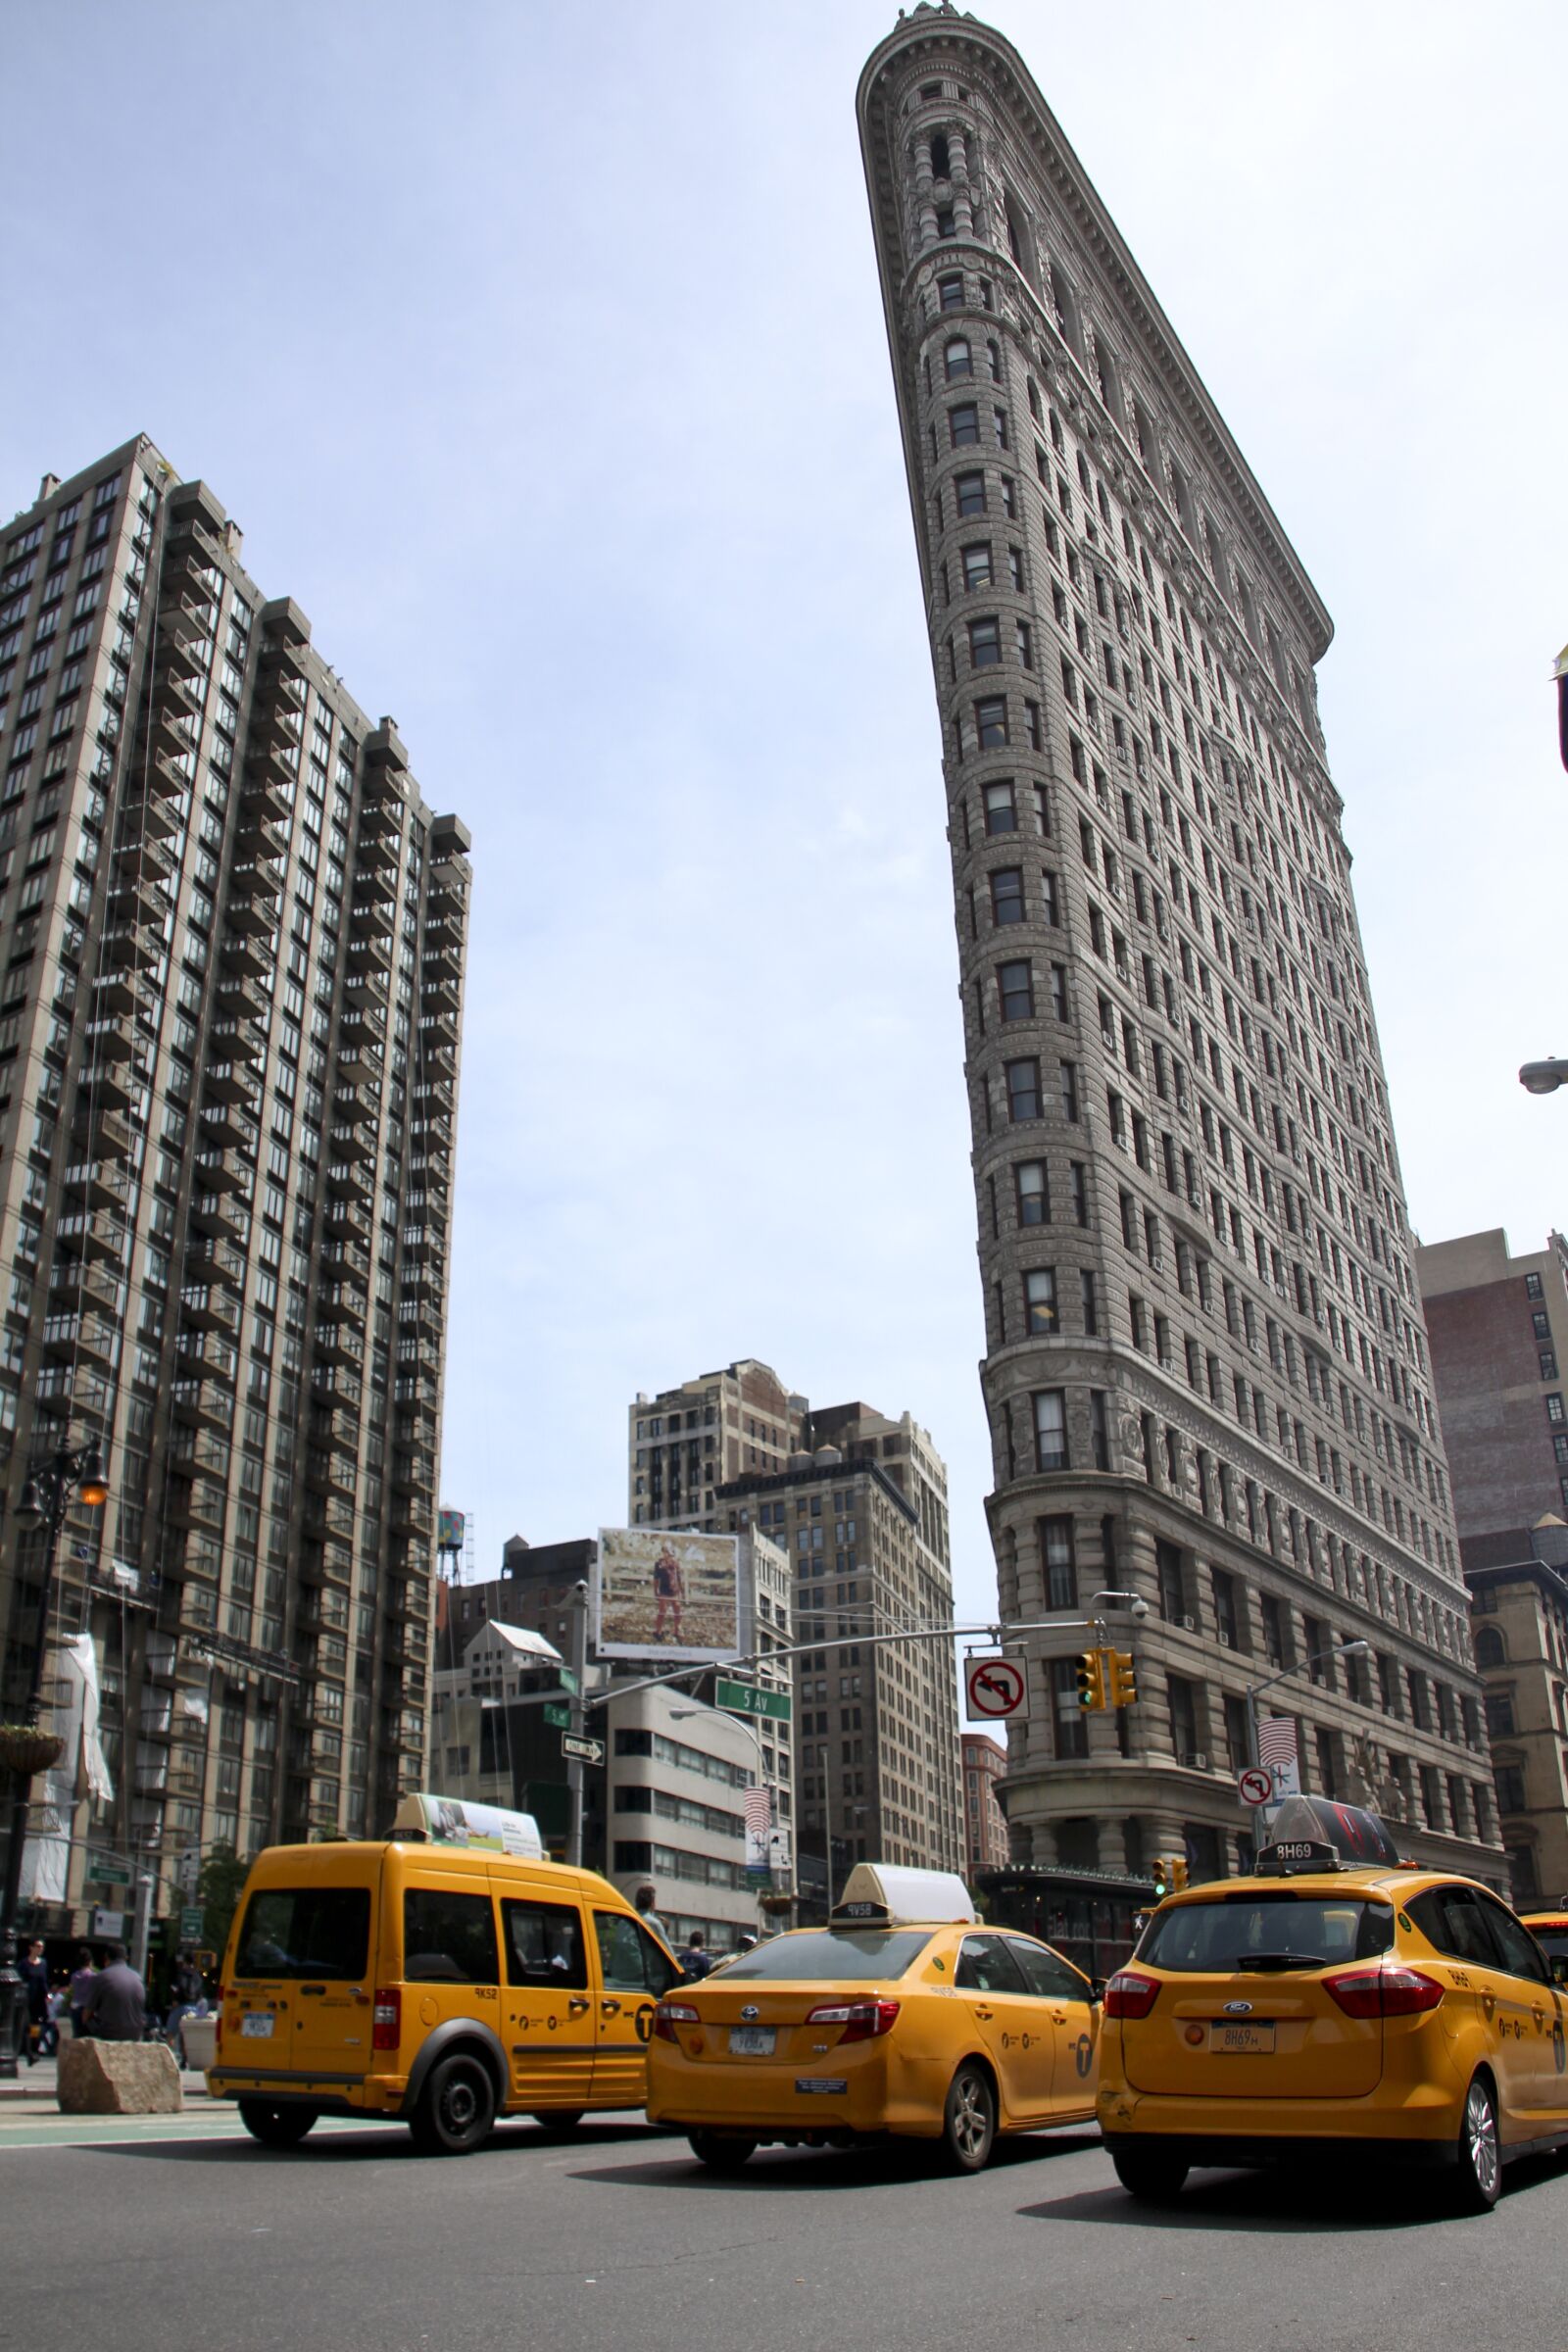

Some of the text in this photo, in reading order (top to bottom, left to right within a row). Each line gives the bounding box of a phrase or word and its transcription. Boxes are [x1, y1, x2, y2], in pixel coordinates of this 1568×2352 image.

[744, 1690, 767, 1711] 5 Av
[568, 1740, 581, 1751] ONE
[1277, 1843, 1311, 1859] 8H69
[848, 1903, 871, 1916] 9V58
[474, 1987, 497, 1999] 9K52
